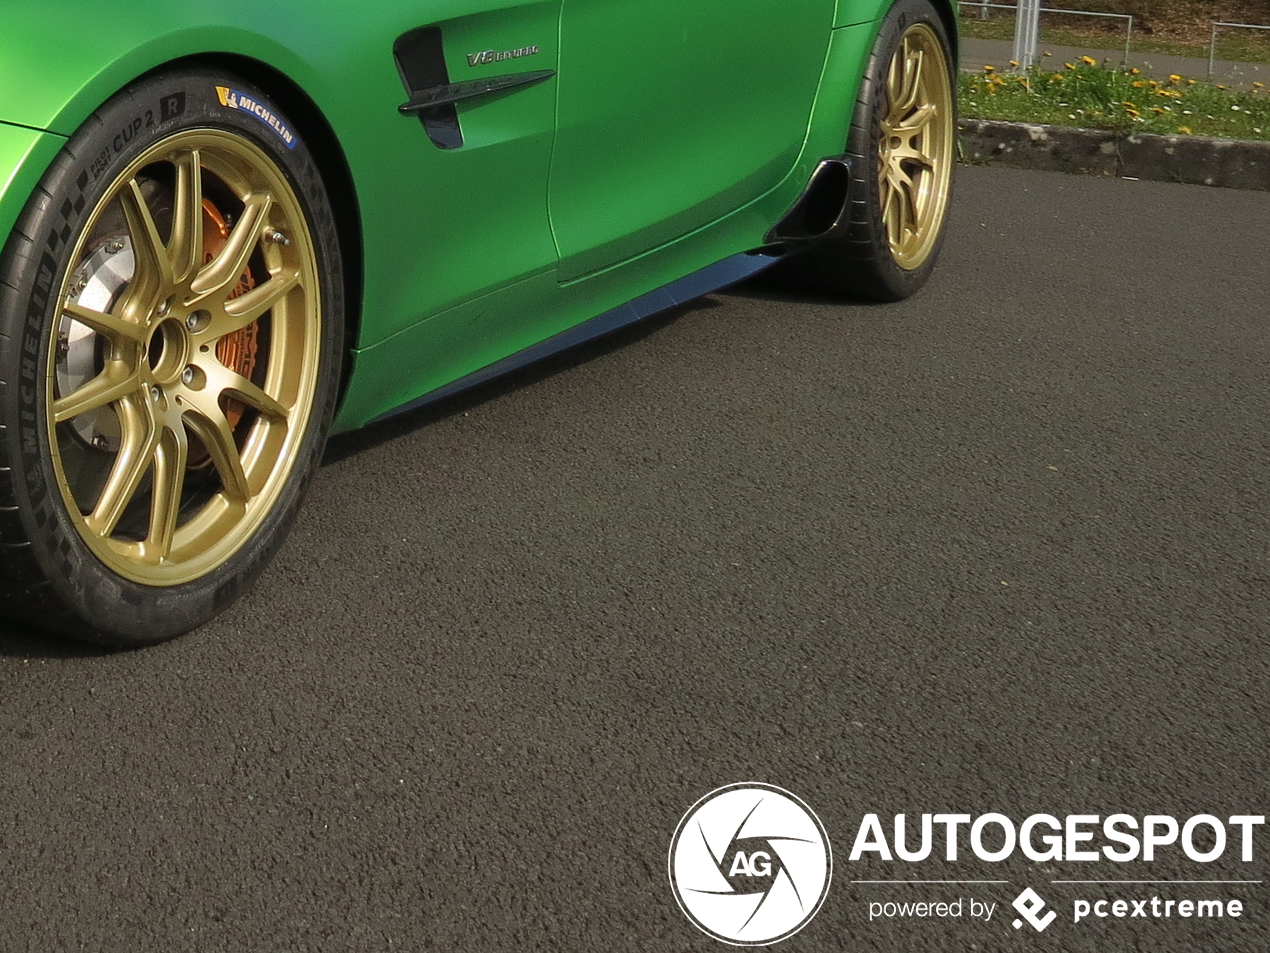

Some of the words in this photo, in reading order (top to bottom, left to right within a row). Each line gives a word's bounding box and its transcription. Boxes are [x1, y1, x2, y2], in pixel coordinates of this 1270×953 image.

[113, 117, 142, 152] CUP
[145, 109, 154, 127] 2
[239, 96, 293, 144] MICHELIN
[22, 262, 54, 455] MICHELIN
